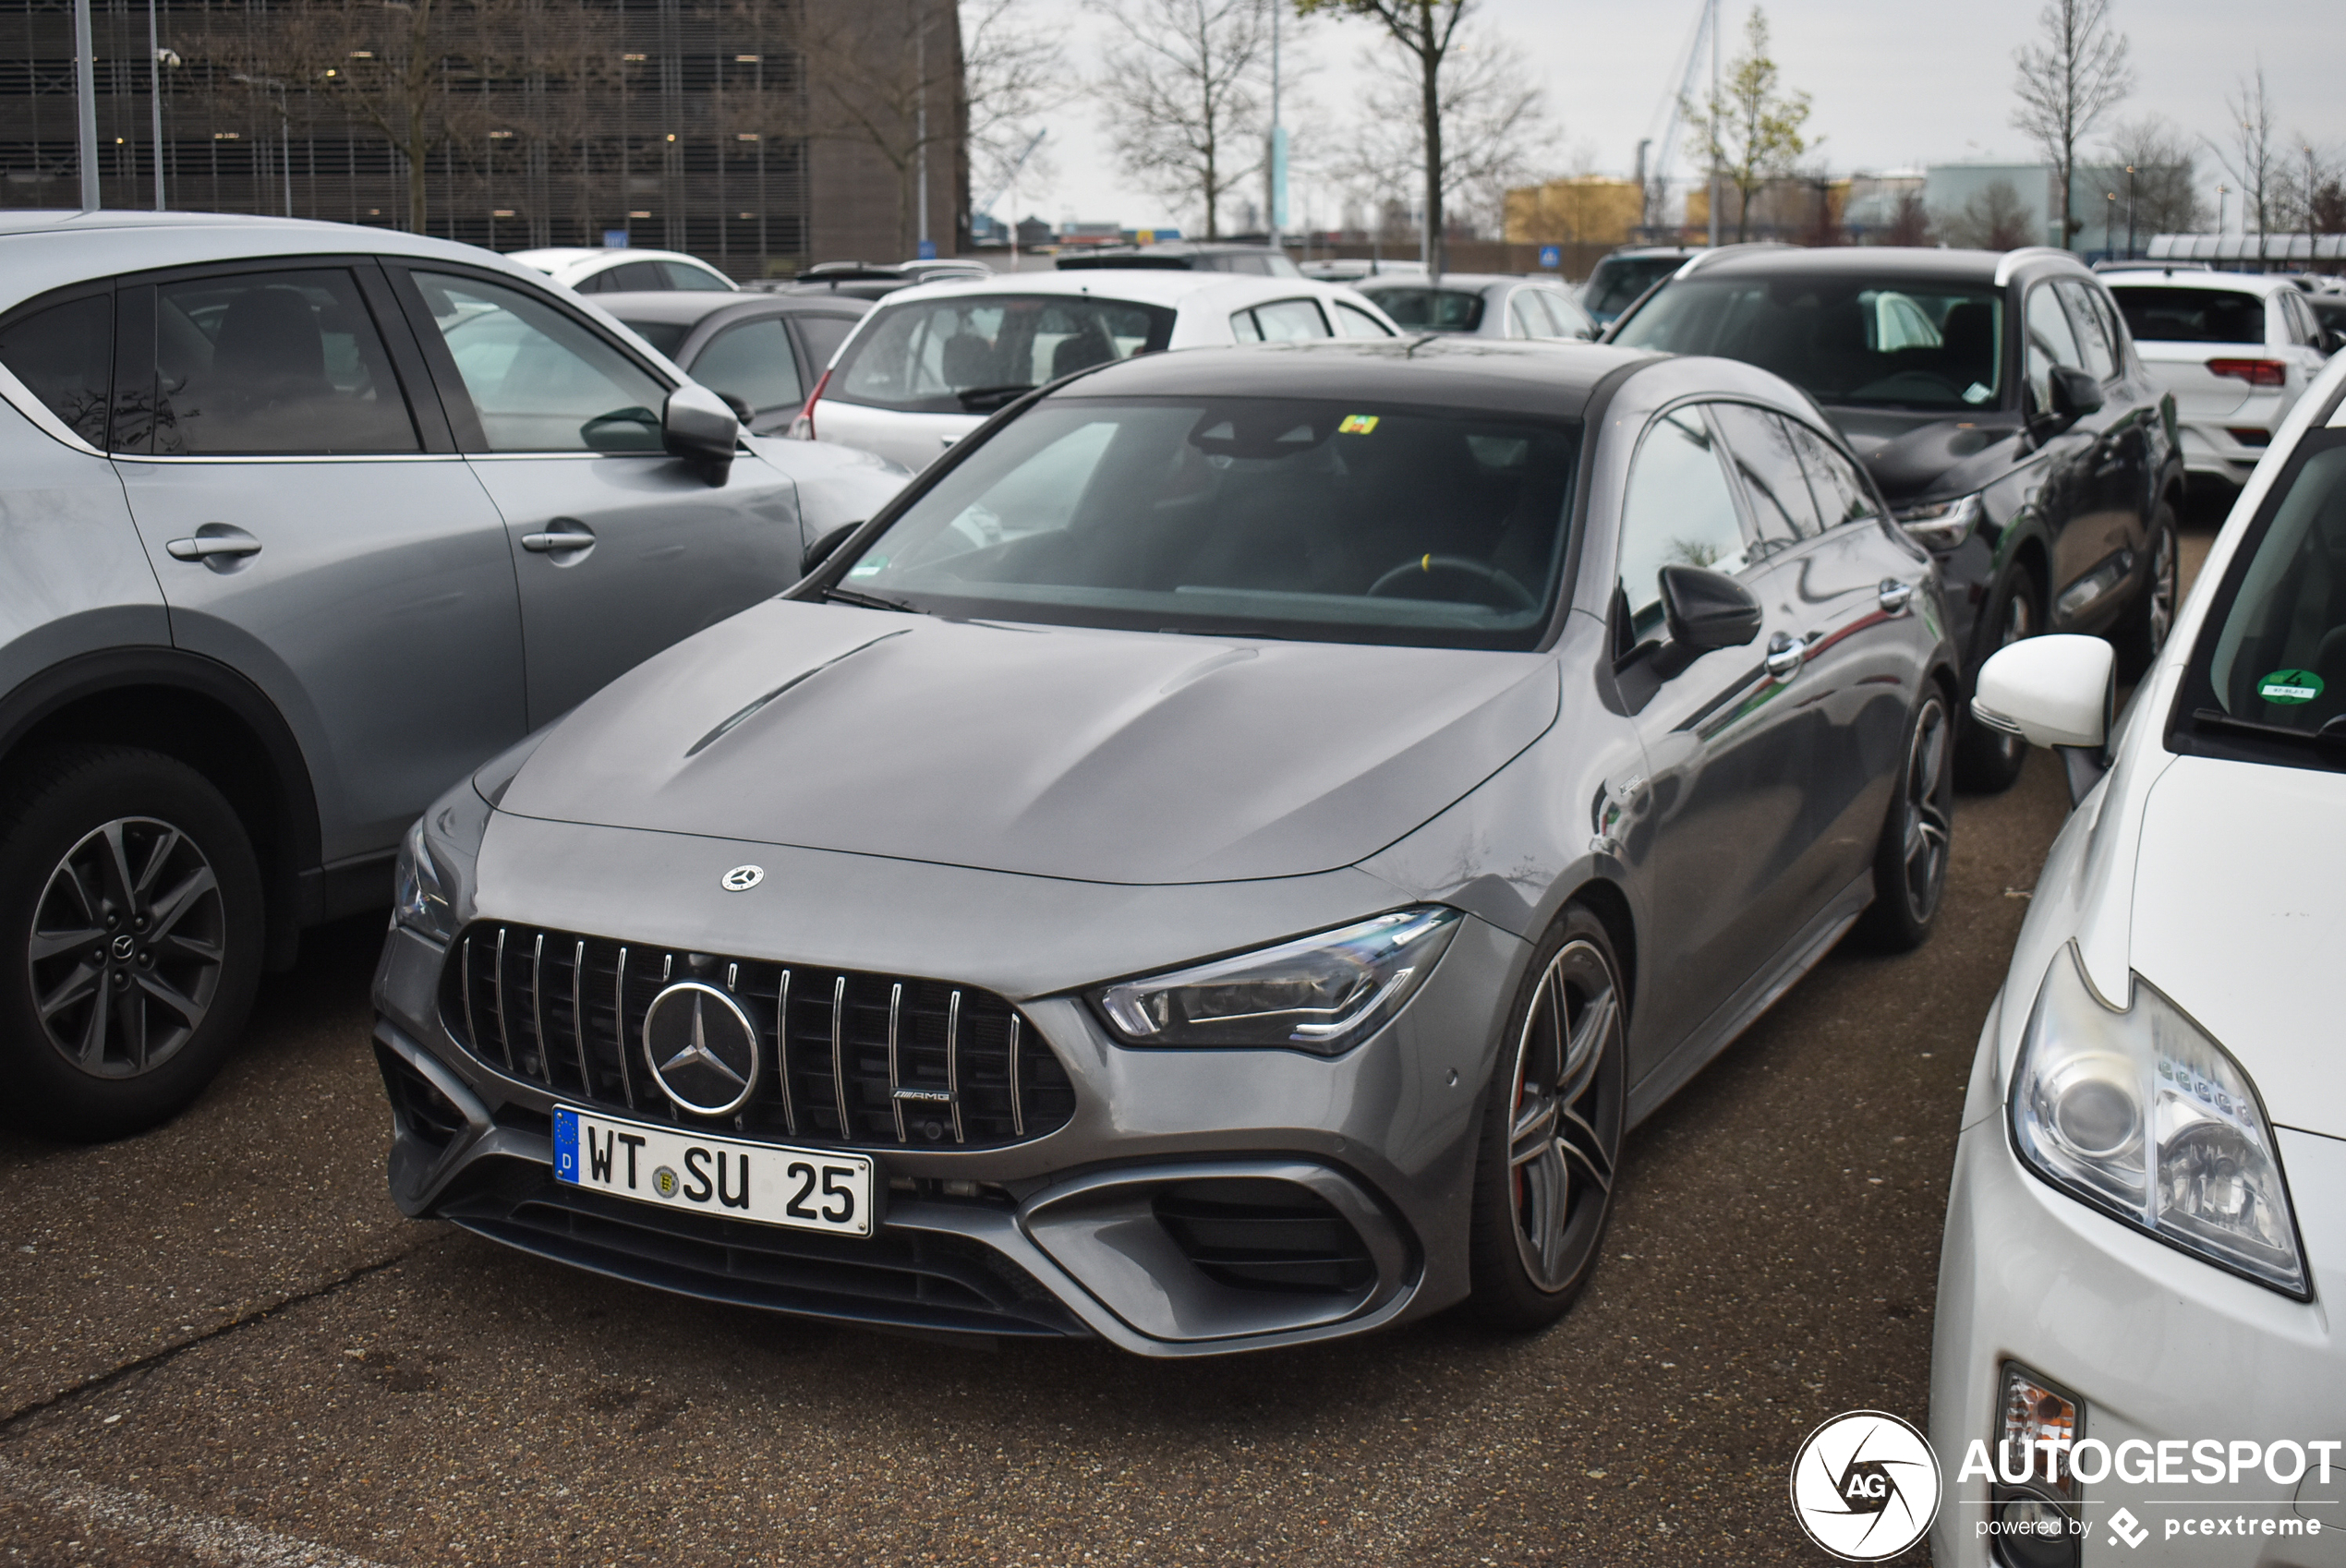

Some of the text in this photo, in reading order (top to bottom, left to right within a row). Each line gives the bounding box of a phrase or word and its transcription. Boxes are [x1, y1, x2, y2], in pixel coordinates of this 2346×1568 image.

[2283, 670, 2302, 686] 4
[909, 1091, 949, 1101] AMG
[562, 1153, 572, 1169] D
[587, 1126, 646, 1189] WT
[683, 1147, 750, 1210] SU
[786, 1162, 854, 1223] 25
